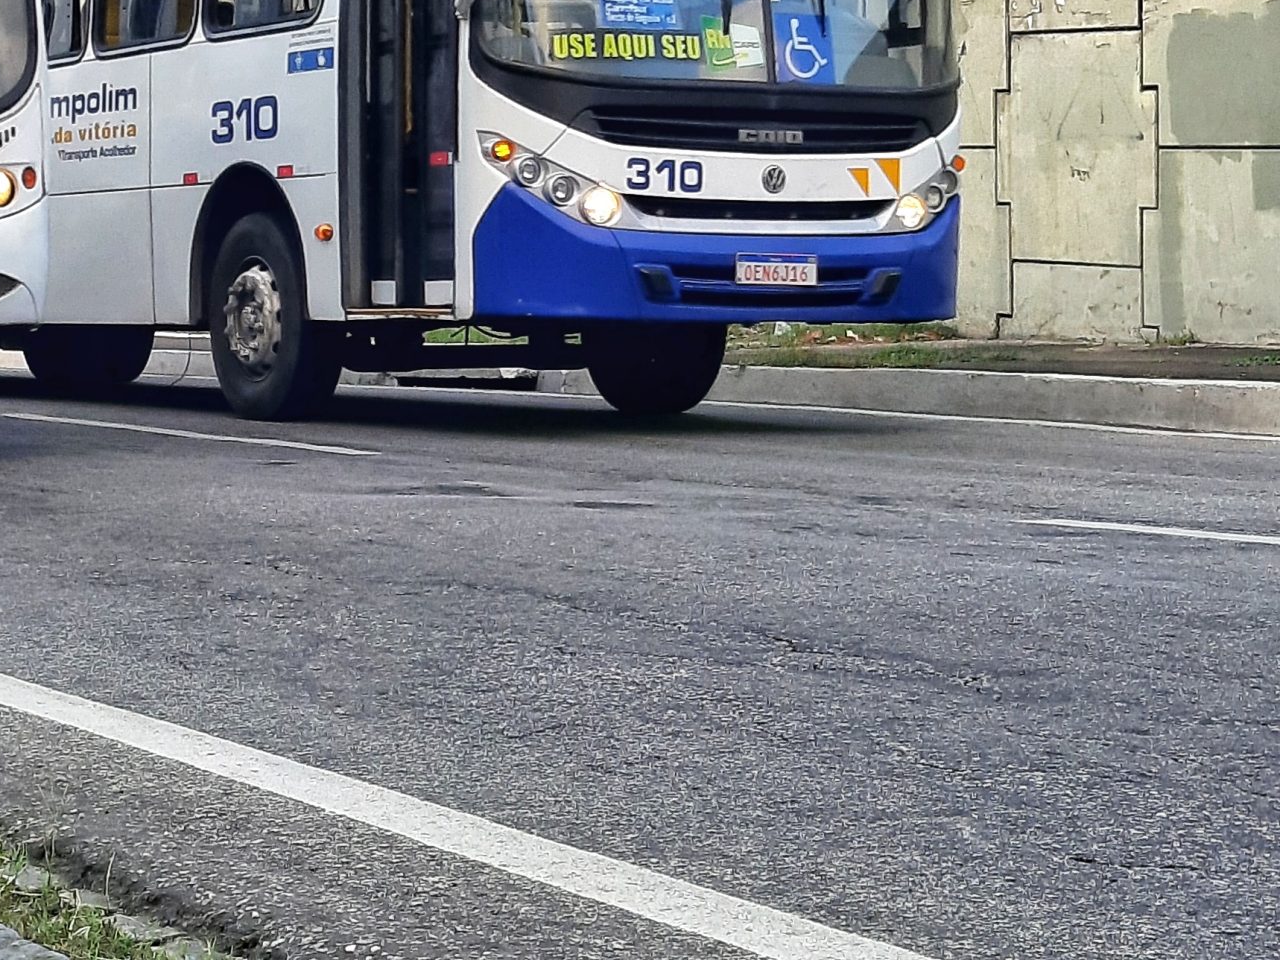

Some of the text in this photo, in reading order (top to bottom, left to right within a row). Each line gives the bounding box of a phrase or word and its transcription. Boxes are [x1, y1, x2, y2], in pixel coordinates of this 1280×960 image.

[553, 33, 702, 60] USE AQUI SEU
[78, 120, 137, 141] vitória
[211, 95, 279, 145] 310
[626, 157, 703, 193] 310
